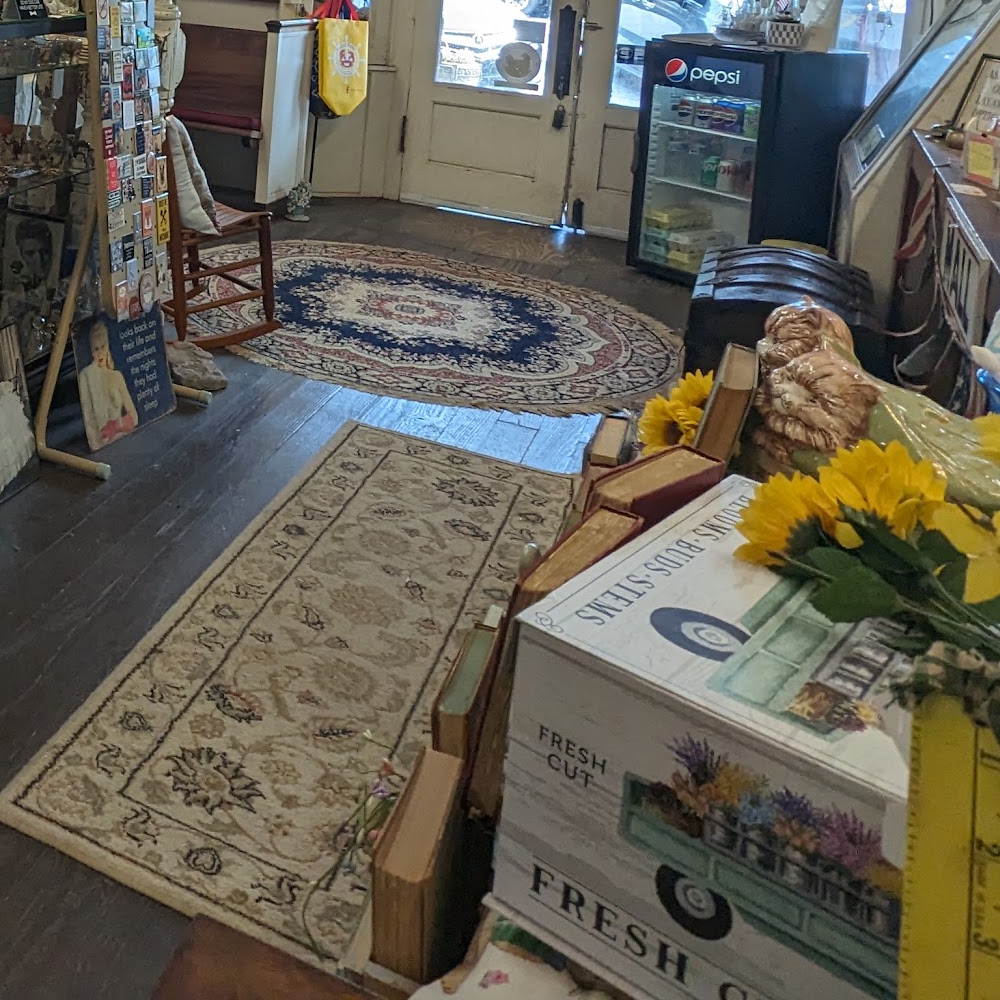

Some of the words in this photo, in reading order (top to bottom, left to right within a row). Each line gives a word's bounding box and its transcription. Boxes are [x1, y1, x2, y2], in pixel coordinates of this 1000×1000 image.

[690, 67, 740, 85] pepsi
[538, 725, 608, 776] FRESH
[547, 754, 595, 789] CUT
[528, 863, 691, 985] FRESH
